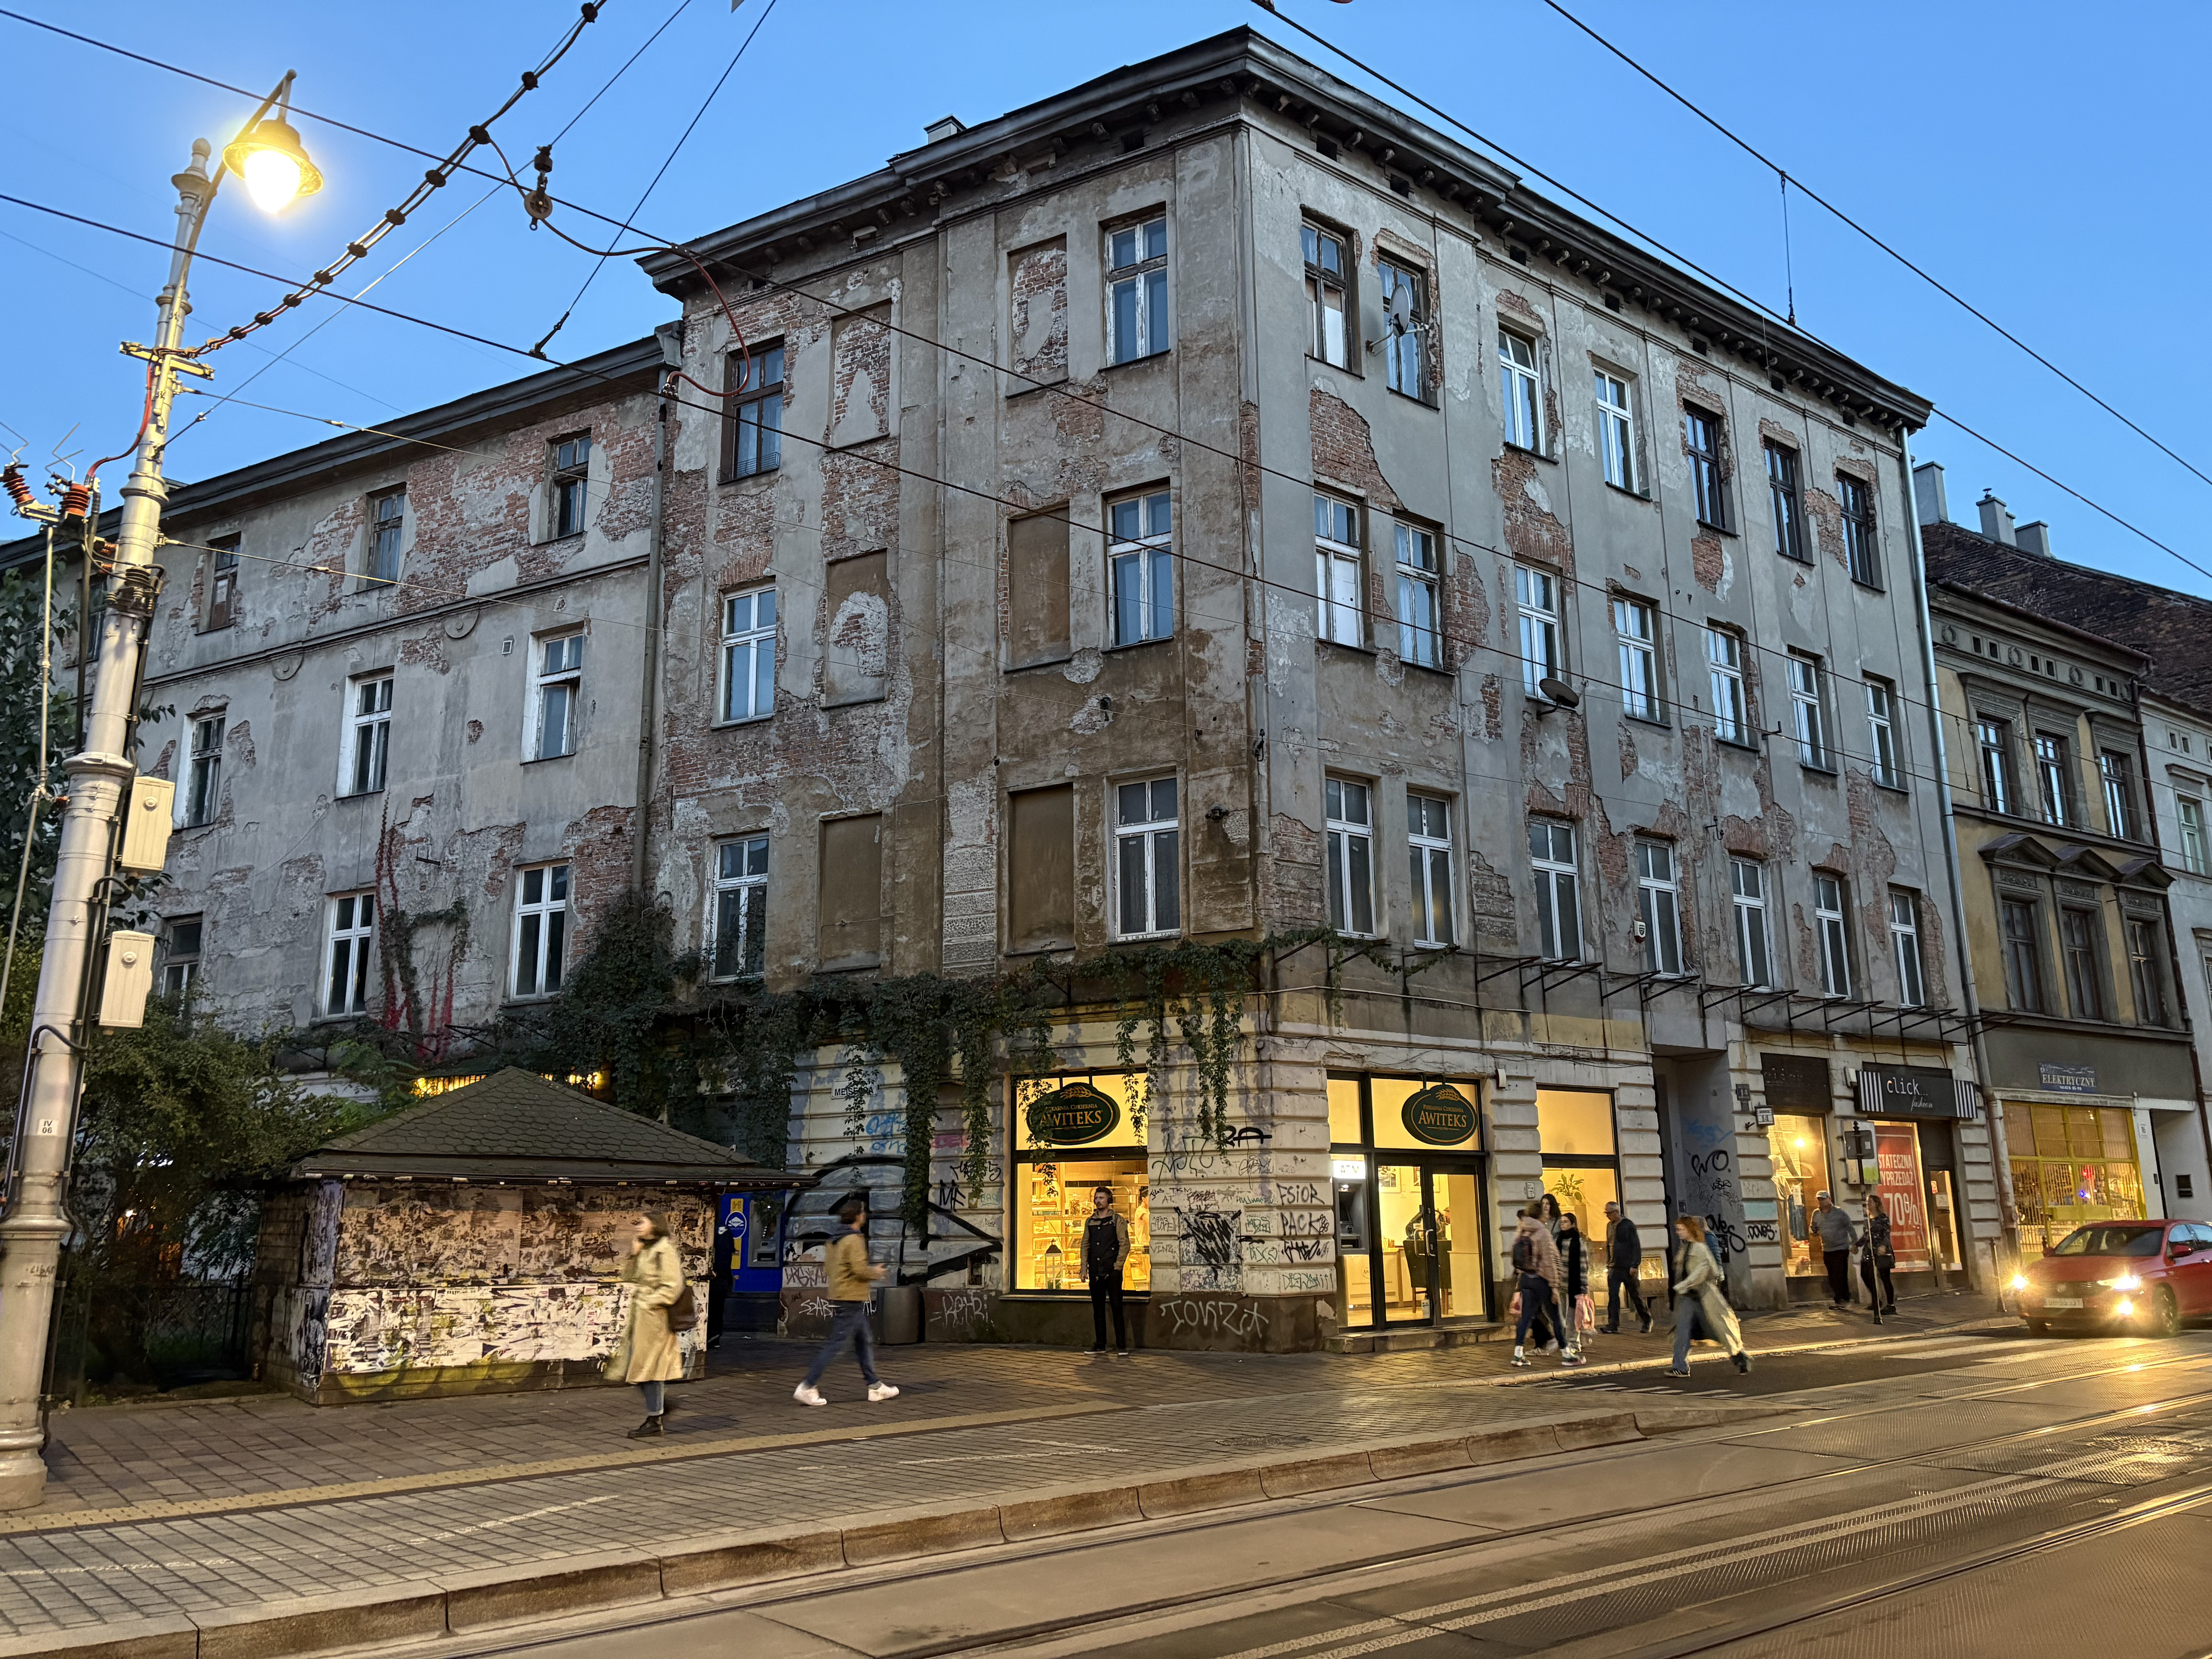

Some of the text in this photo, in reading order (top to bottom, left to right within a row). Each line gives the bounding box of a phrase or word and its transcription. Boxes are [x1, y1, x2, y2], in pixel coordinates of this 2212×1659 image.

[2042, 1074, 2095, 1087] ELEKTRYCZNY
[834, 1086, 874, 1096] MEISEA
[1911, 1096, 1933, 1112] fashion
[1418, 1110, 1467, 1128] AWITEKS
[1878, 1154, 1913, 1169] STATECZNA
